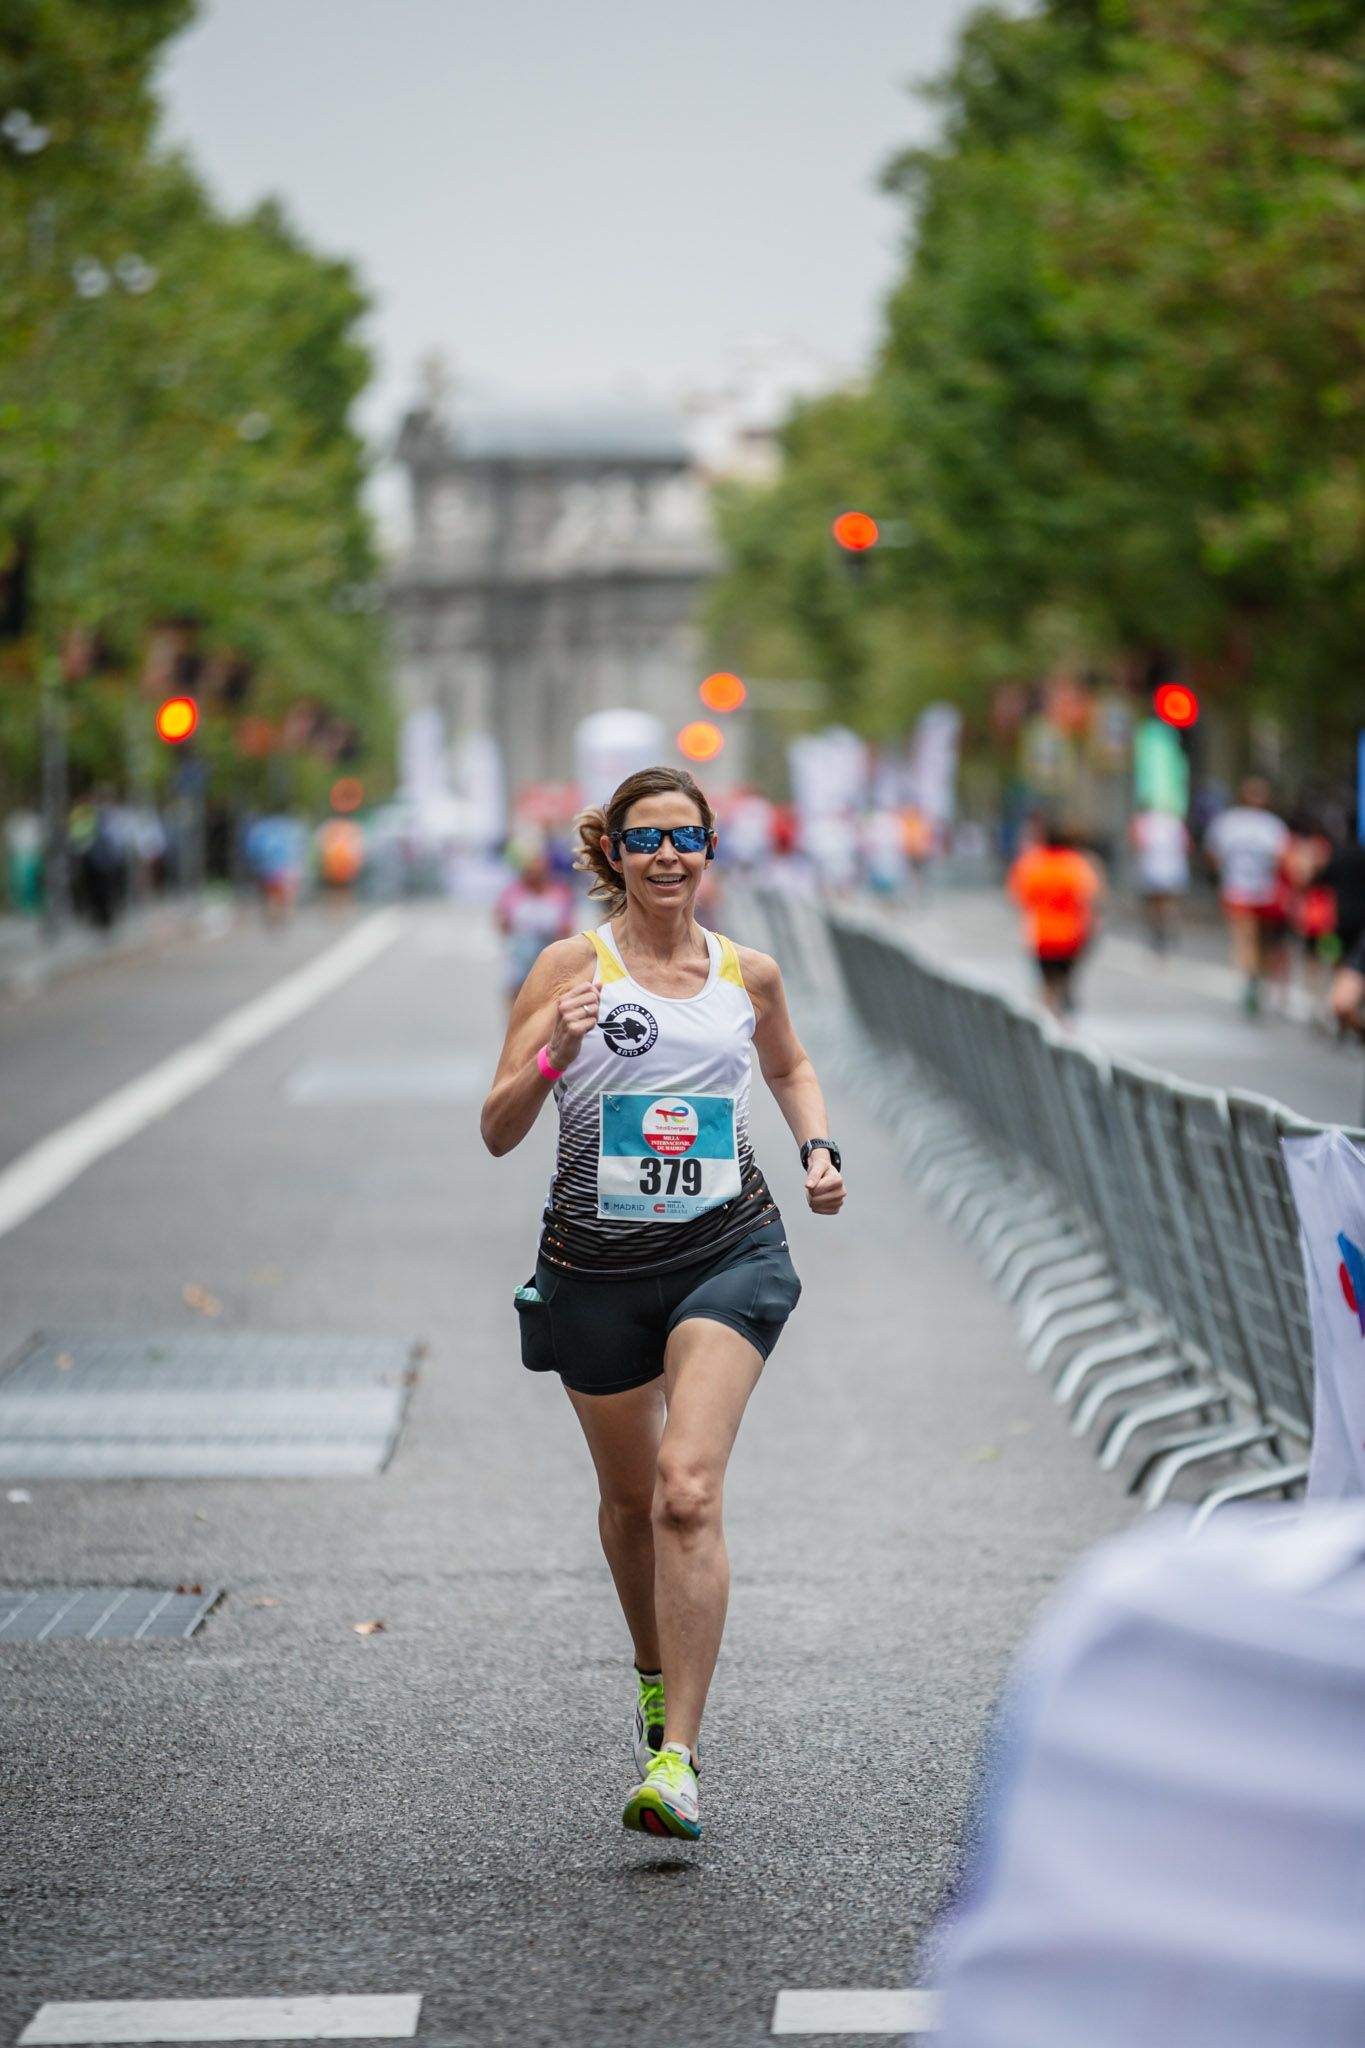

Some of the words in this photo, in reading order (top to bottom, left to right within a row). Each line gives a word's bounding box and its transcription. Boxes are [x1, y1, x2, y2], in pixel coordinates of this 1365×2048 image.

[611, 1004, 641, 1017] TIGERS
[644, 1012, 658, 1050] RUNNING
[616, 1048, 639, 1056] CLUB
[640, 1157, 701, 1196] 379
[613, 1203, 645, 1211] MADRID
